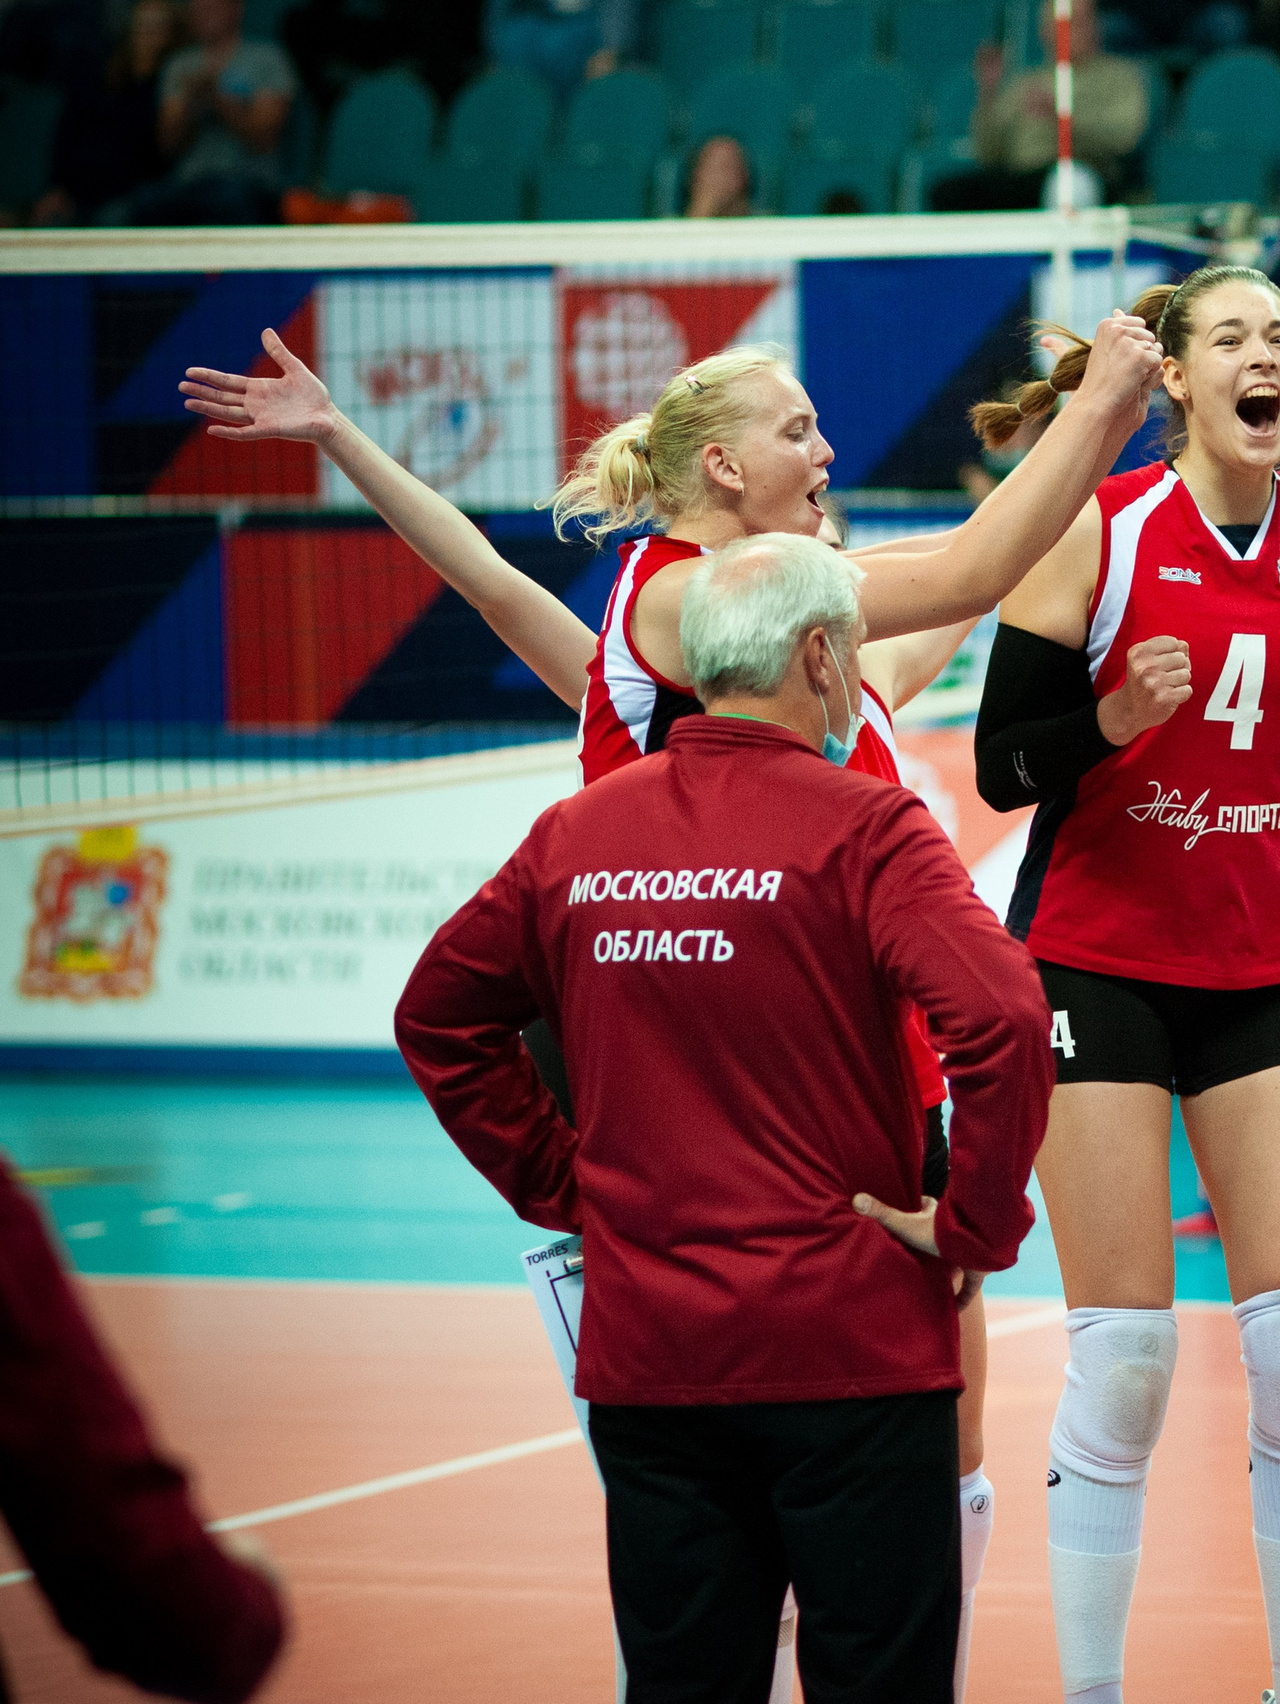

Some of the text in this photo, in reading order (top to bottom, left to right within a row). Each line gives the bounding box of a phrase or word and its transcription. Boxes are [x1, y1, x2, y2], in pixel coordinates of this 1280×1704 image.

[1204, 633, 1266, 750] 4
[1126, 781, 1210, 850] Живу
[568, 868, 783, 906] МОСКОВСКАЯ
[594, 929, 735, 963] ОБЛАСТЬ
[1050, 1010, 1075, 1058] 4
[525, 1243, 569, 1266] TORRES
